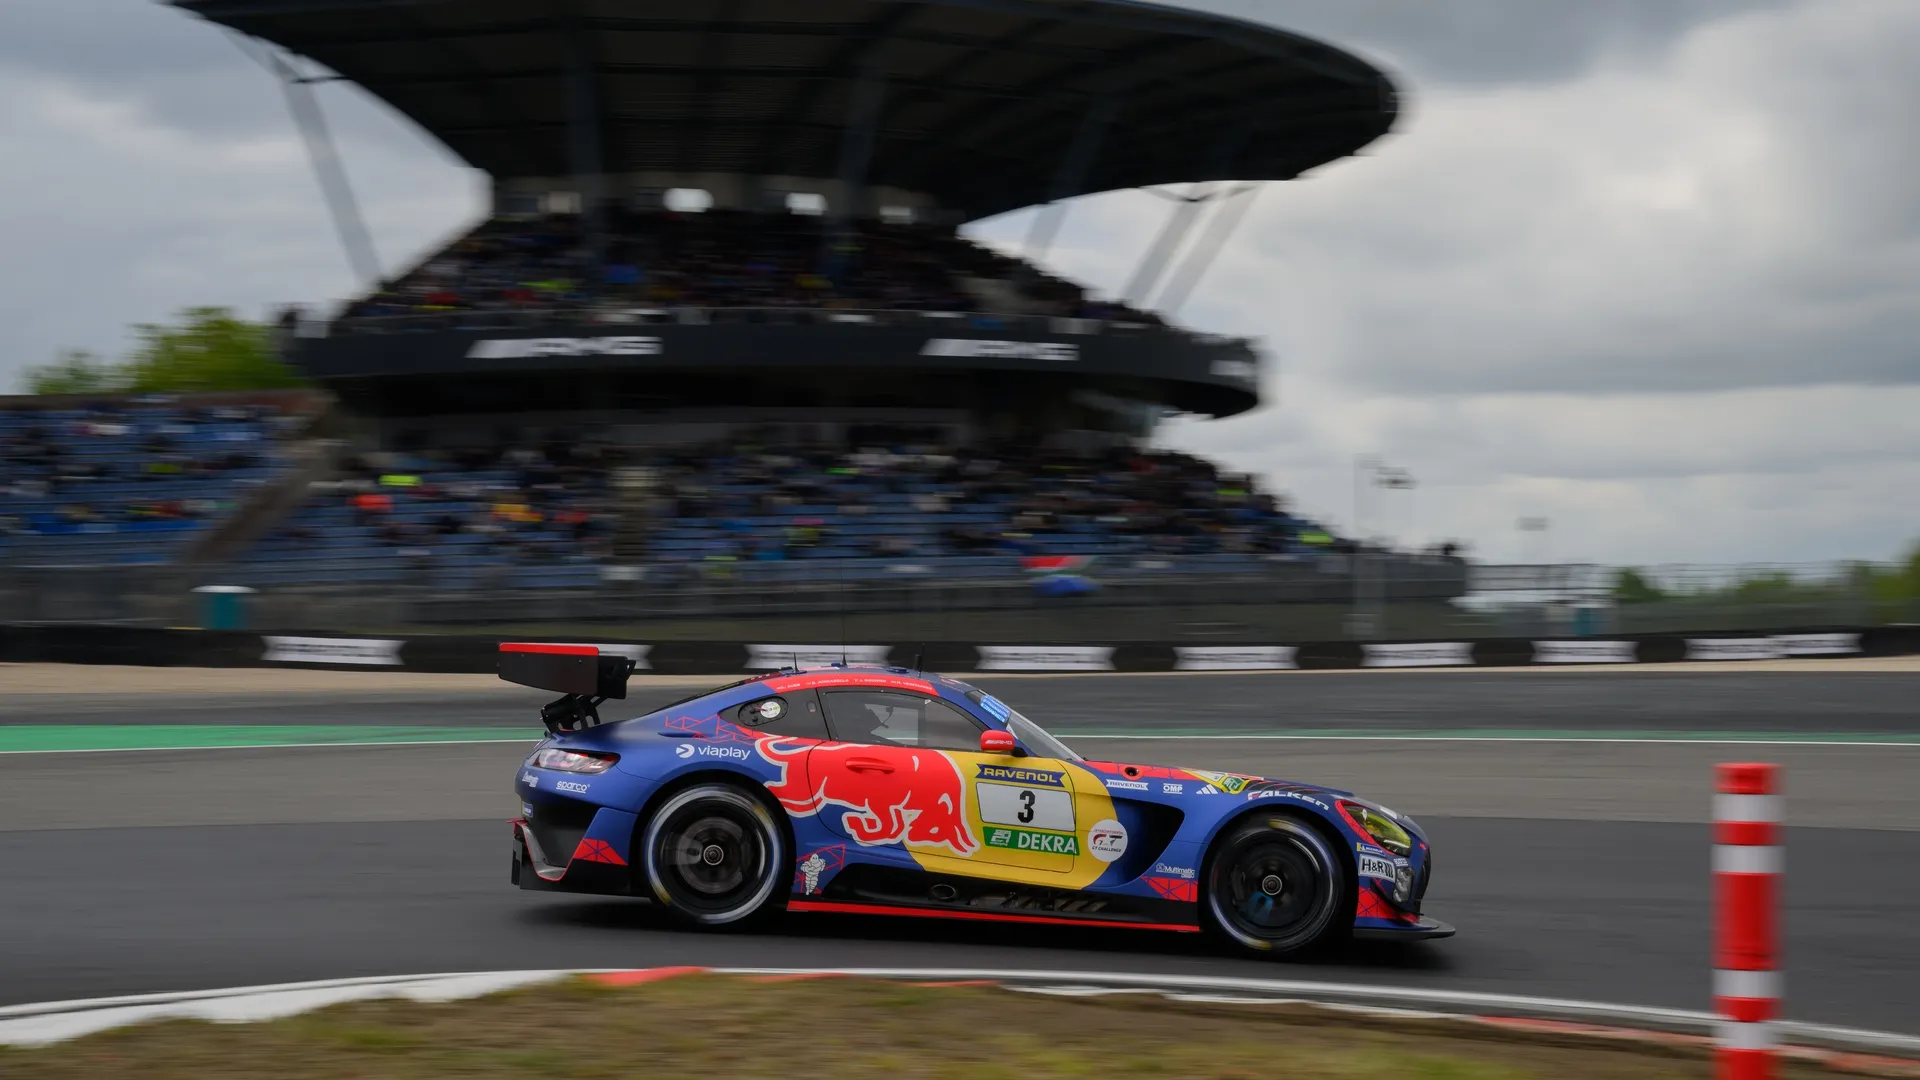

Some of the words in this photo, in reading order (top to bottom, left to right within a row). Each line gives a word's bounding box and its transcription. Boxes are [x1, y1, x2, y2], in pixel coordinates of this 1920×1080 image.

[697, 745, 751, 760] viaplay
[983, 767, 1058, 783] RAVENOL
[556, 780, 588, 792] sparco
[1109, 781, 1145, 789] RAVENOL
[1017, 790, 1036, 824] 3
[1247, 790, 1330, 811] FALKEN
[1017, 831, 1078, 854] DEKRA
[1362, 857, 1385, 874] H&R
